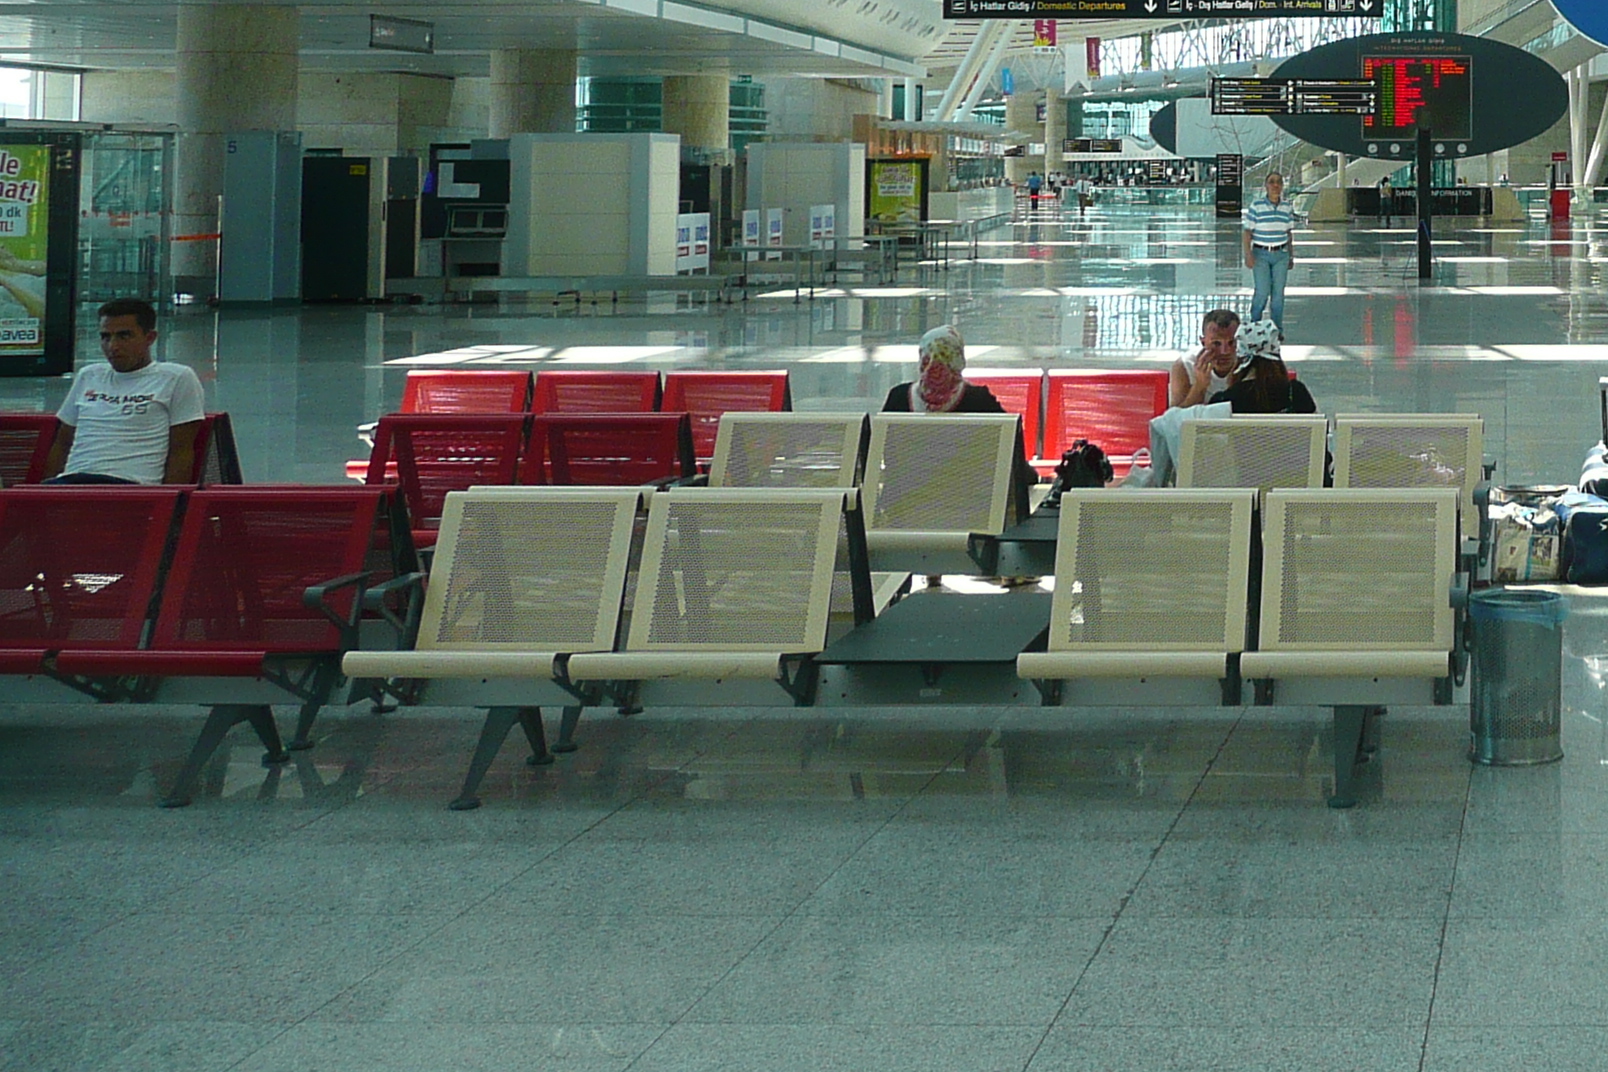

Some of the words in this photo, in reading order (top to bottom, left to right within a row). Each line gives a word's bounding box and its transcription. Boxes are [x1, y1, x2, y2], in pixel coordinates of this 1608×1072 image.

[980, 1, 1005, 11] Hatlar
[1008, 1, 1029, 13] Gidiş
[1037, 2, 1077, 11] Domestic
[1078, 1, 1126, 12] Departures
[1213, 0, 1234, 9] Hatlar
[1296, 0, 1322, 9] Arrivals
[1396, 190, 1417, 198] DANIŞ
[2, 330, 35, 340] avea
